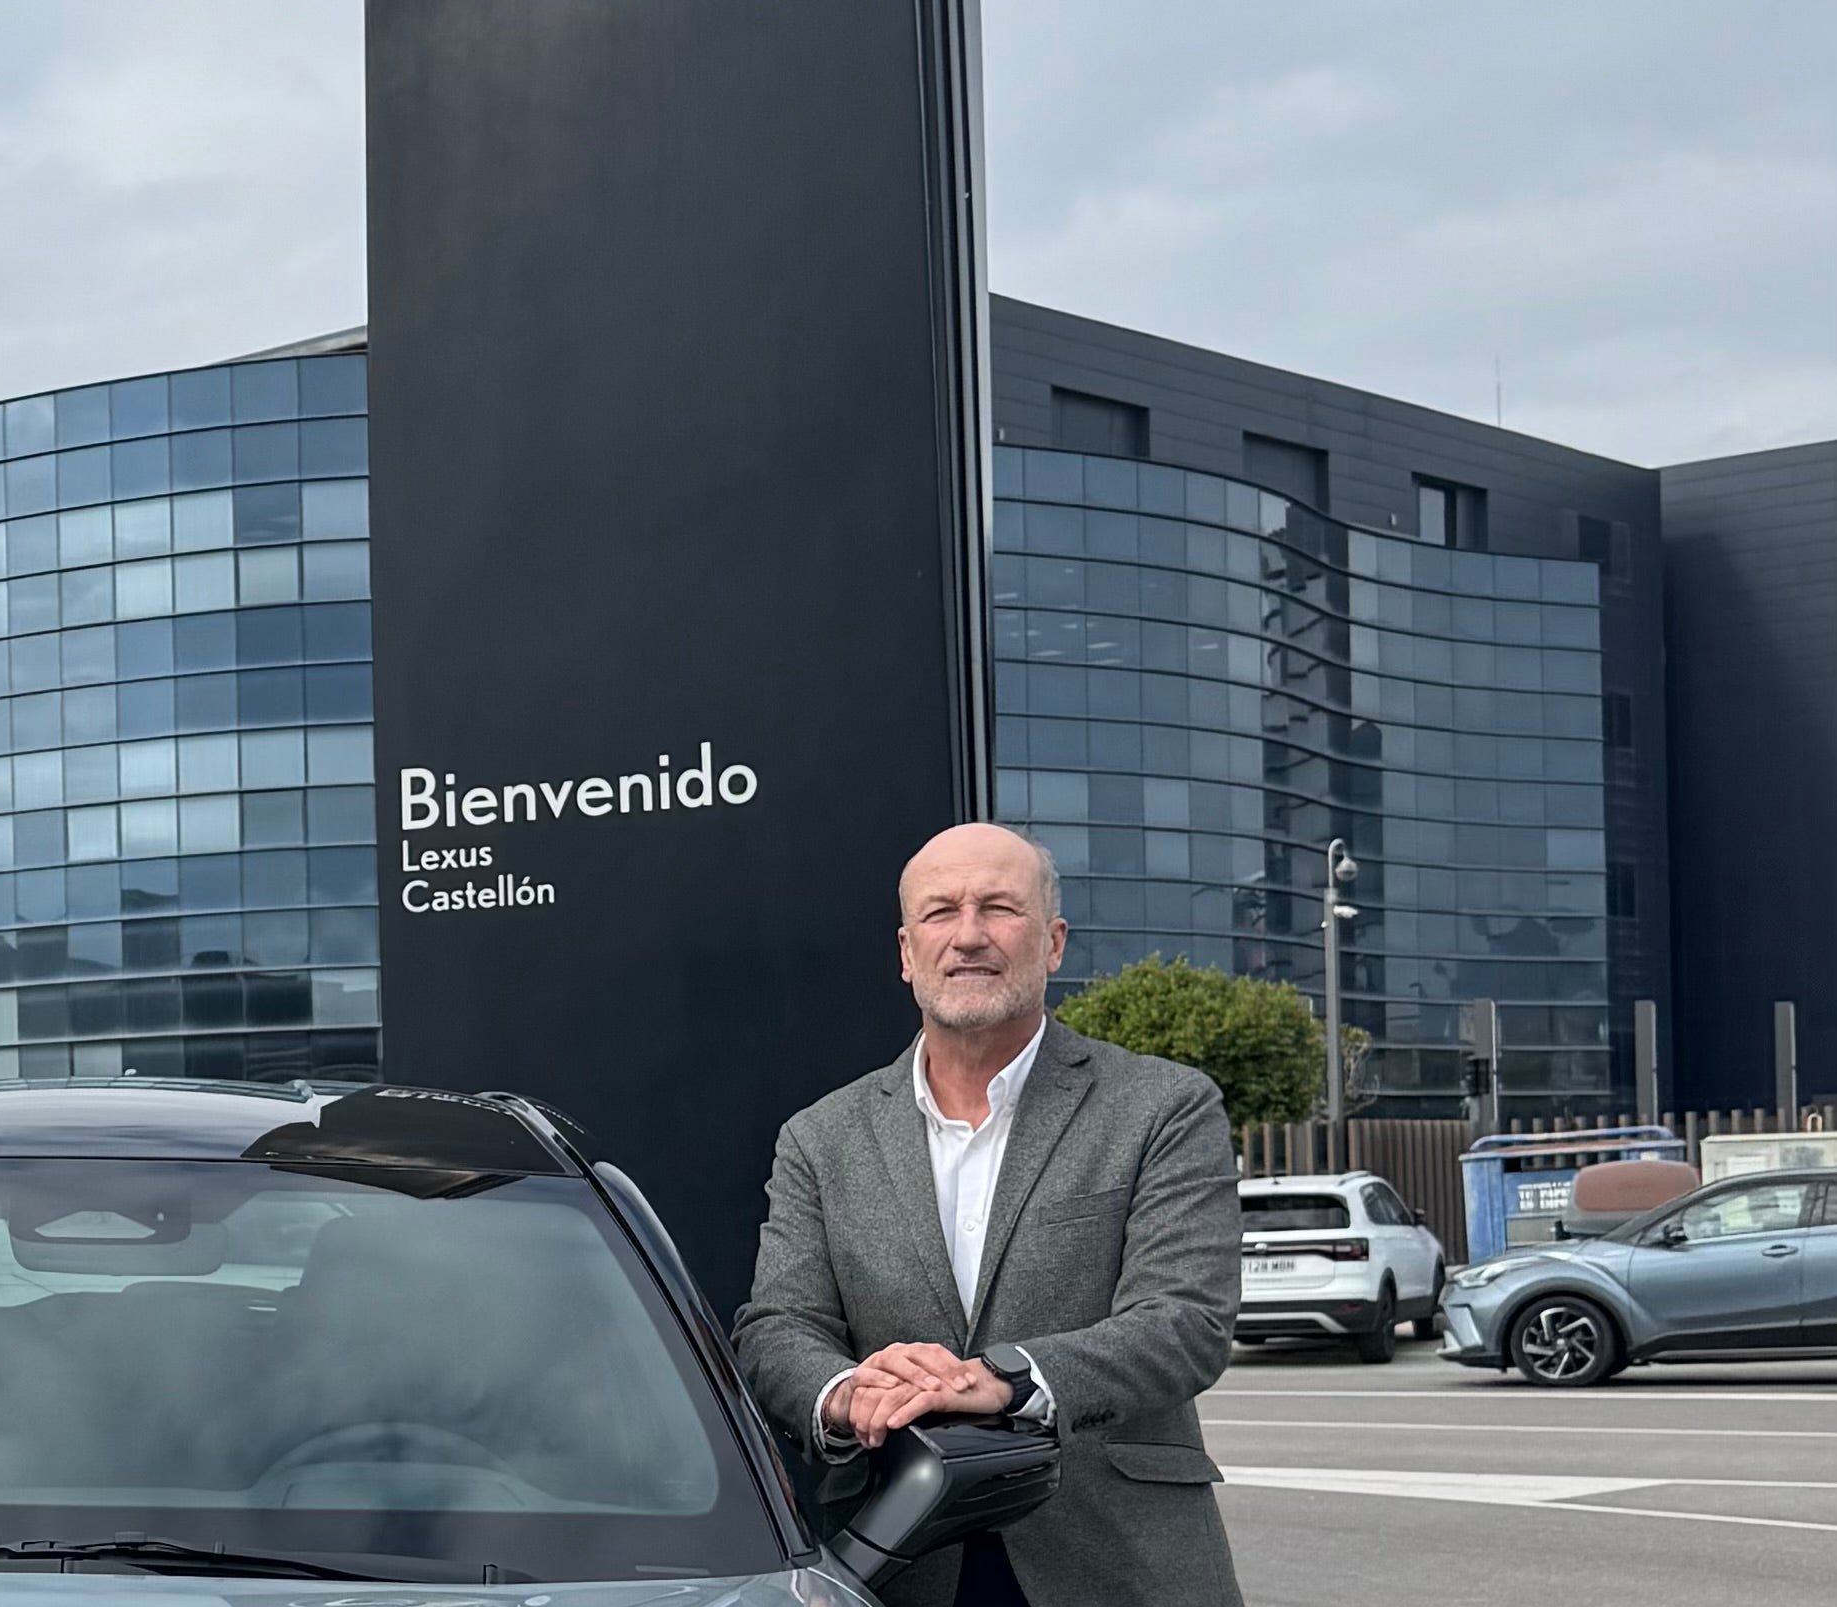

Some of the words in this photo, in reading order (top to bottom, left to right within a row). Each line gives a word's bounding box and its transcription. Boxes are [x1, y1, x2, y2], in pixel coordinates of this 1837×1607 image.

[400, 742, 757, 830] Bienvenido
[401, 840, 493, 872] Lexus
[401, 874, 555, 913] Castellón
